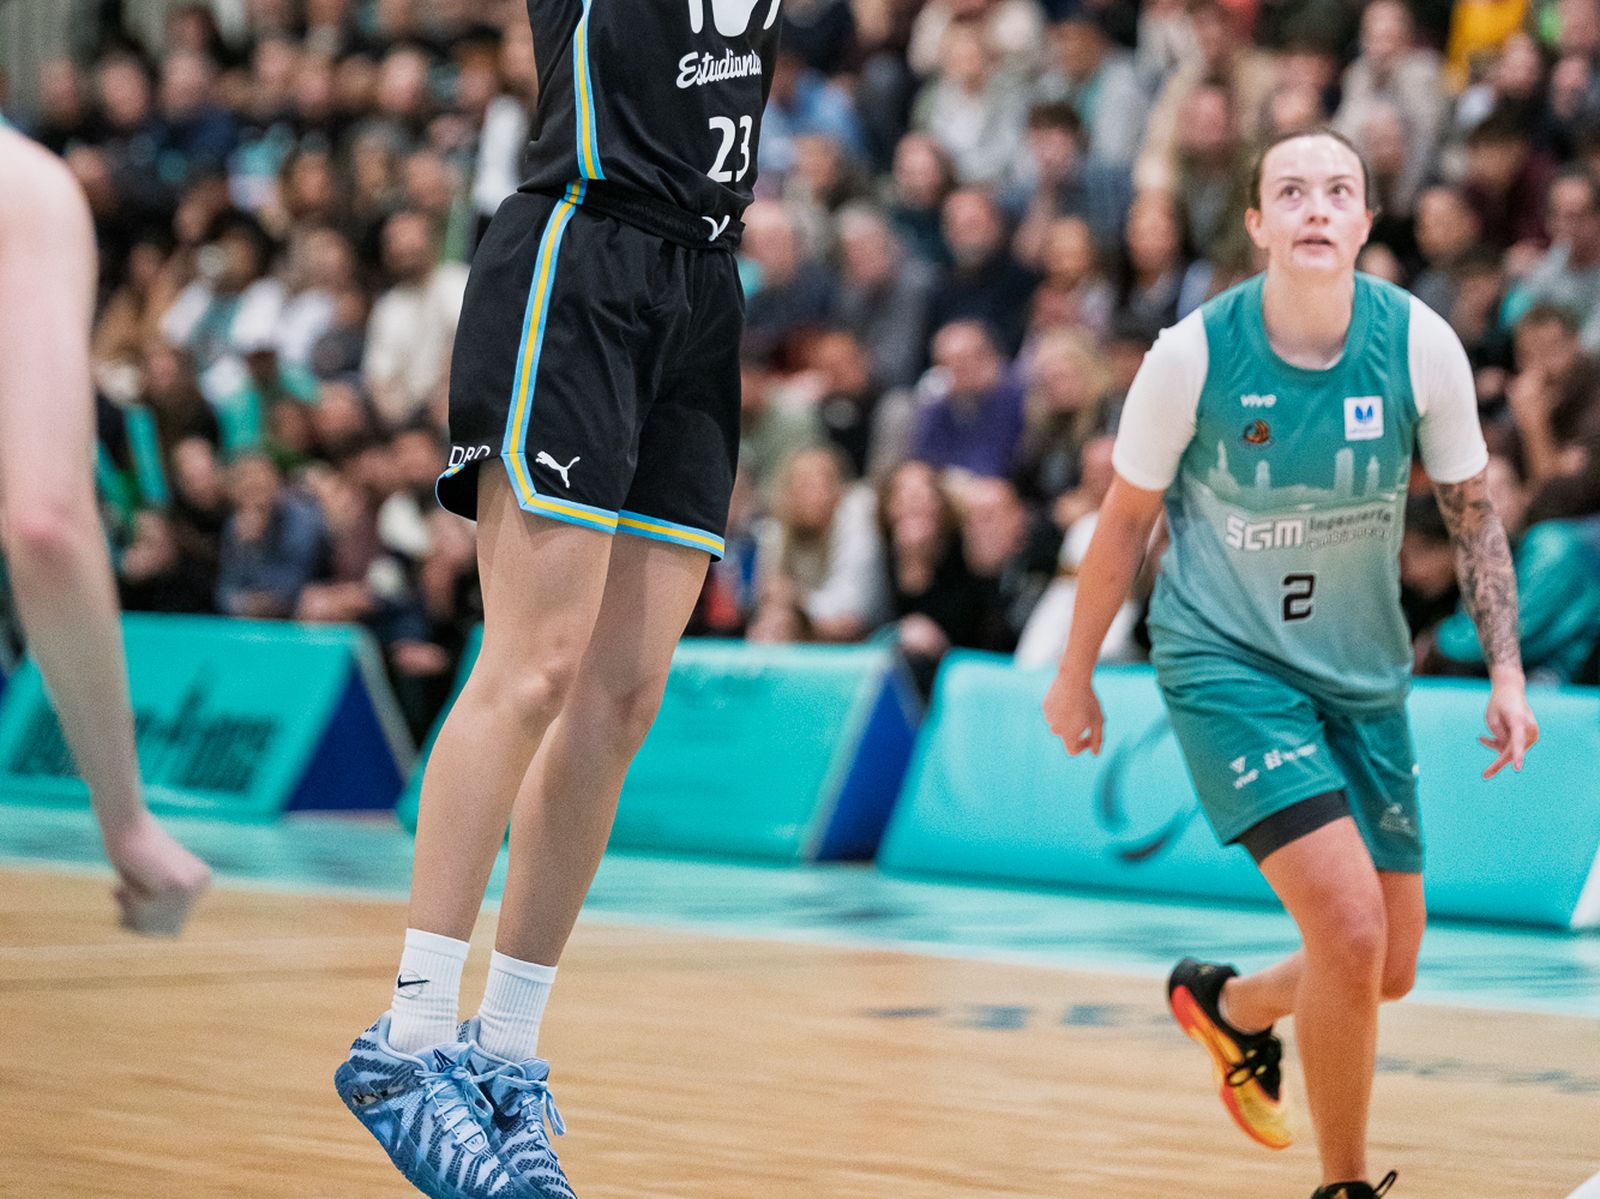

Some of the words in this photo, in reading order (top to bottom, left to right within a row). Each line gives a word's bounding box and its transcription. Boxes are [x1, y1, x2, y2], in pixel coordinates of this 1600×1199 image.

[707, 115, 752, 183] 23
[1225, 513, 1305, 551] SGM
[1282, 575, 1316, 622] 2
